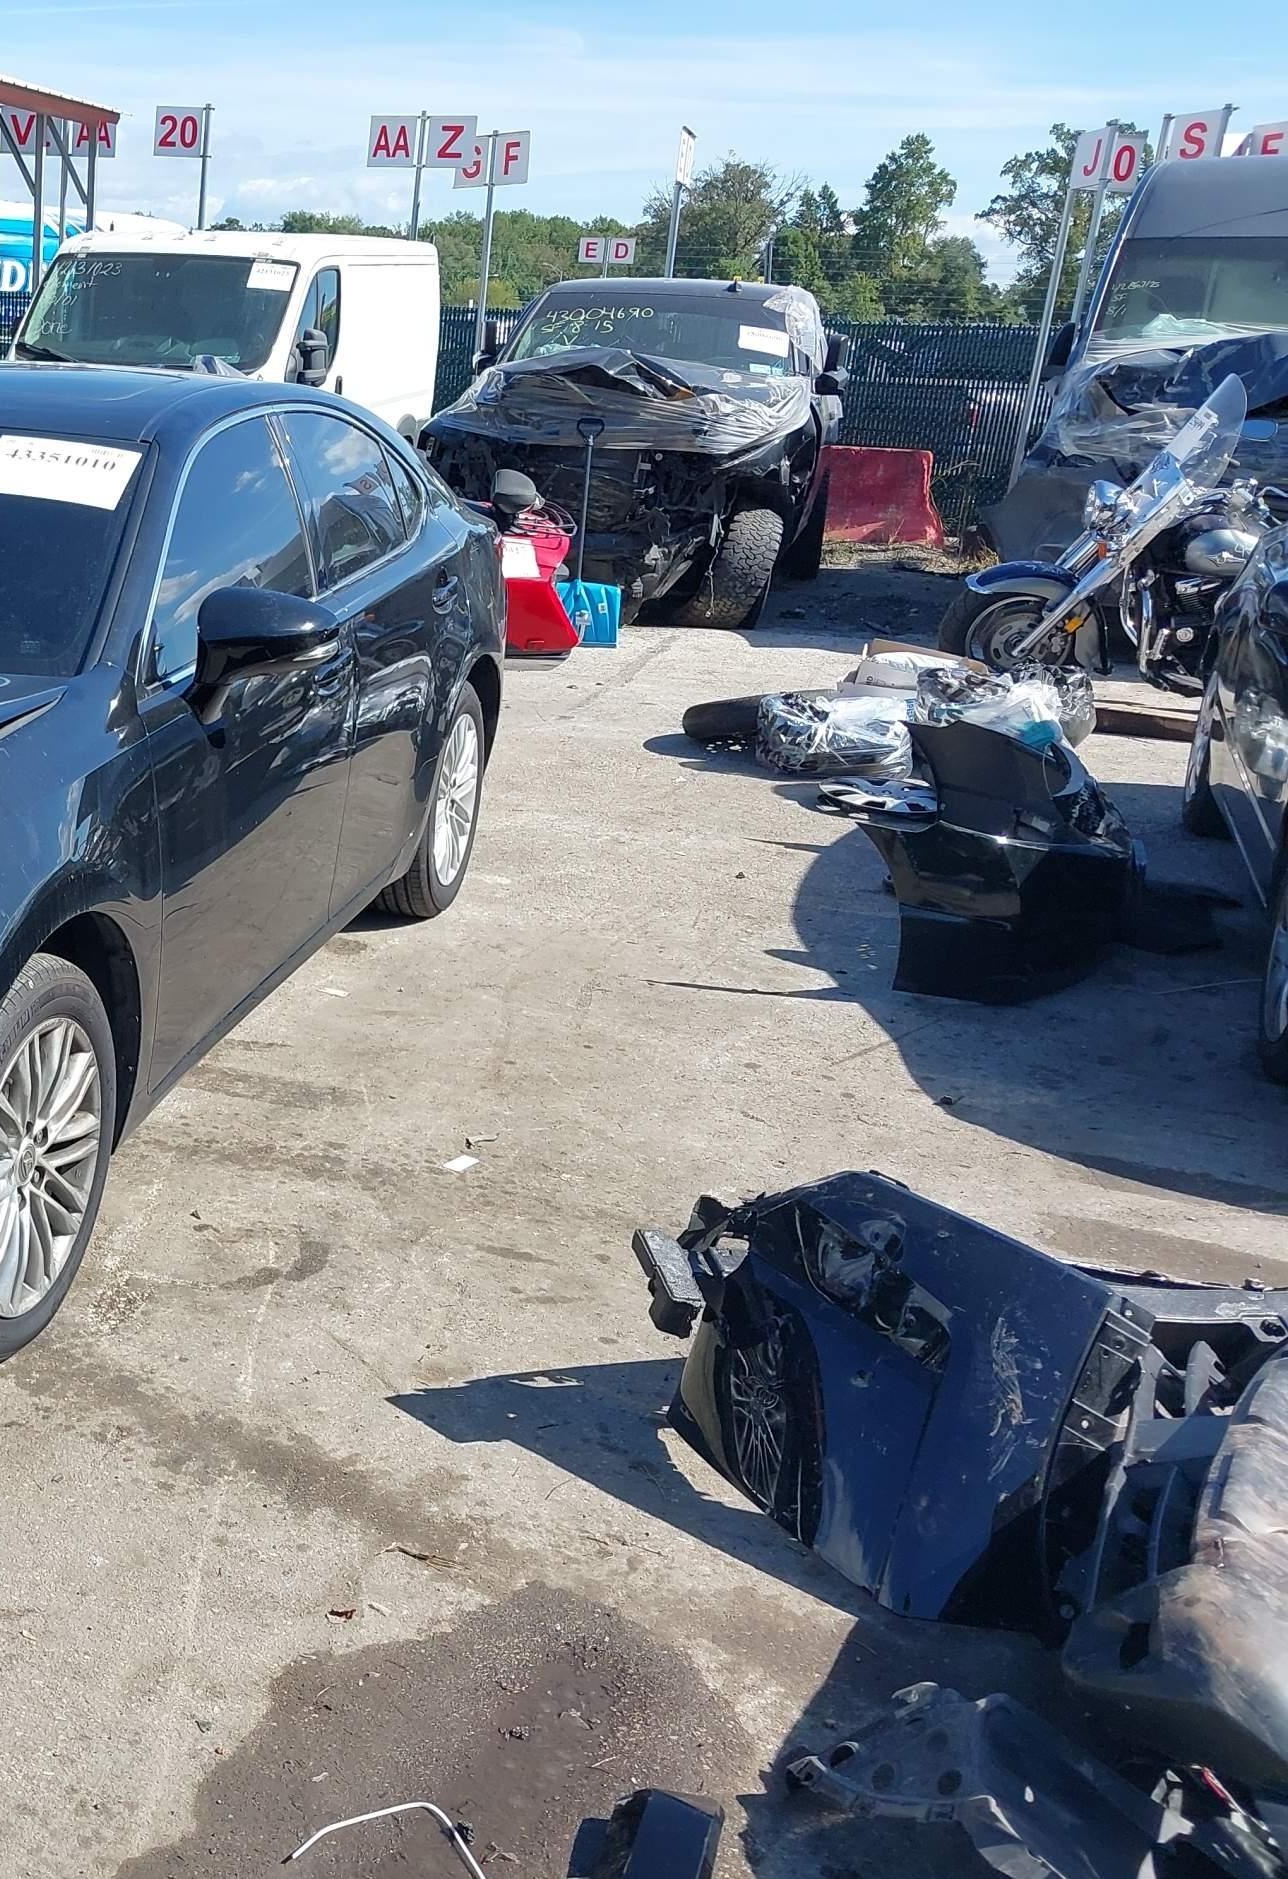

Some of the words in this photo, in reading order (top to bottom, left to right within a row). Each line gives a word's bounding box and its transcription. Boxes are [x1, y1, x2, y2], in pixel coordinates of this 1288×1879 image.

[11, 114, 36, 146] V
[158, 115, 198, 149] 20
[372, 125, 410, 158] AA
[437, 125, 465, 159] Z
[1179, 121, 1208, 160] S
[504, 141, 521, 175] F
[1083, 139, 1103, 177] J
[585, 242, 598, 258] E
[615, 243, 628, 259] D
